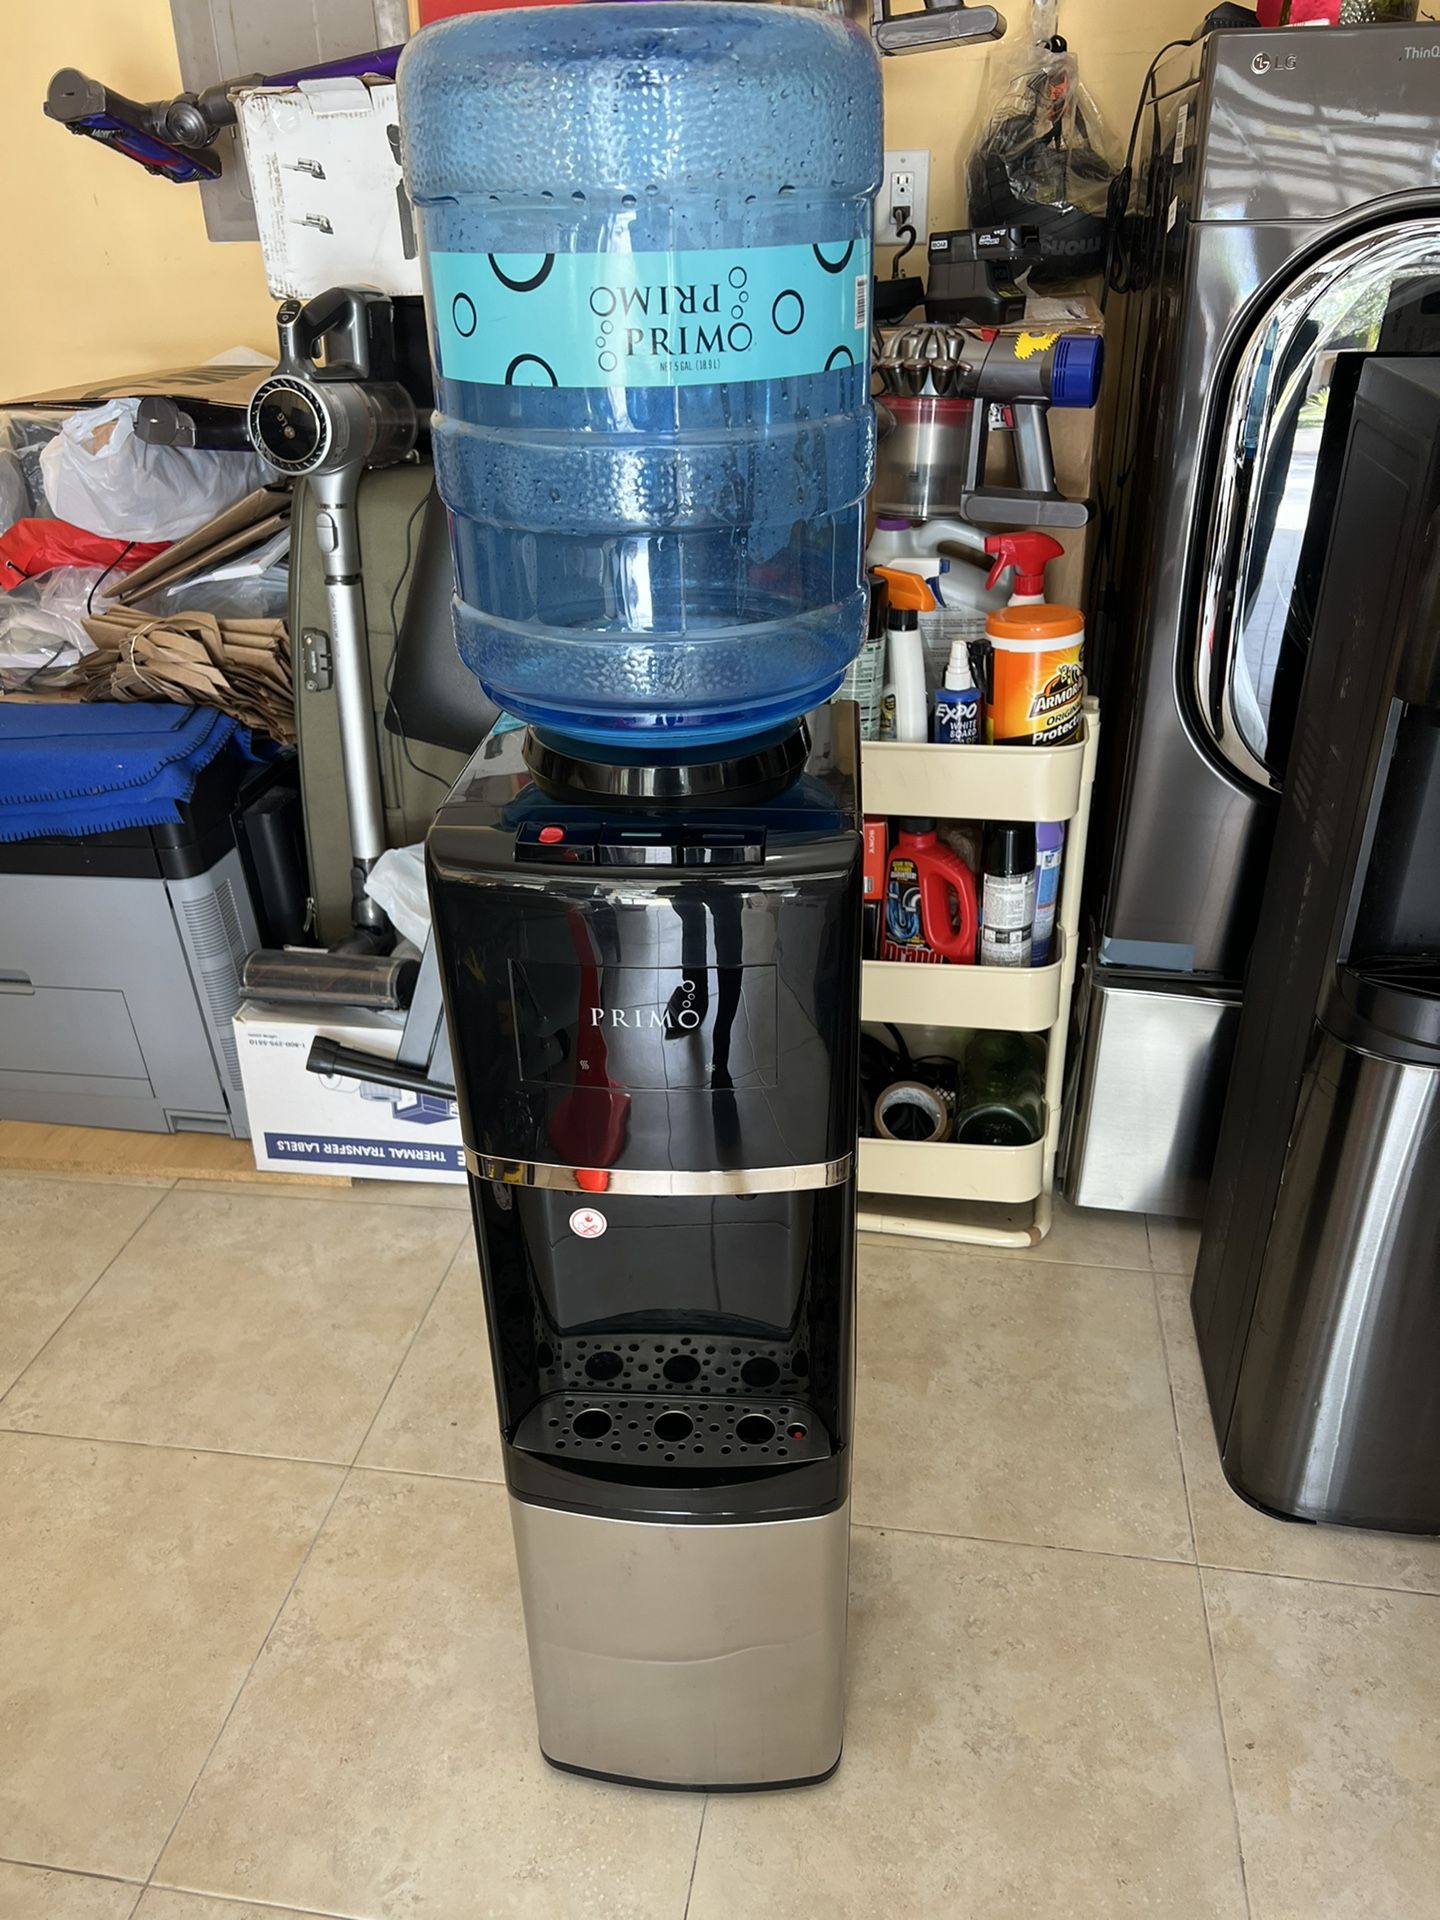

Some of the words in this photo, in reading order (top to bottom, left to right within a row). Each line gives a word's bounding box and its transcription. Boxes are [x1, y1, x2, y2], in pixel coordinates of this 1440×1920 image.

[1404, 45, 1440, 59] ThinQ
[1274, 54, 1297, 70] LG
[590, 284, 720, 317] PRIMO
[624, 322, 753, 356] PRIMO
[674, 361, 679, 371] 5
[935, 702, 978, 725] EXPO
[949, 719, 977, 730] WHITE
[949, 728, 978, 738] BOARD
[868, 829, 876, 854] SONY
[590, 1007, 700, 1029] PRIMO
[276, 1140, 320, 1153] LABELS
[323, 1143, 386, 1158] TRANSFER
[390, 1147, 447, 1163] THERMAL
